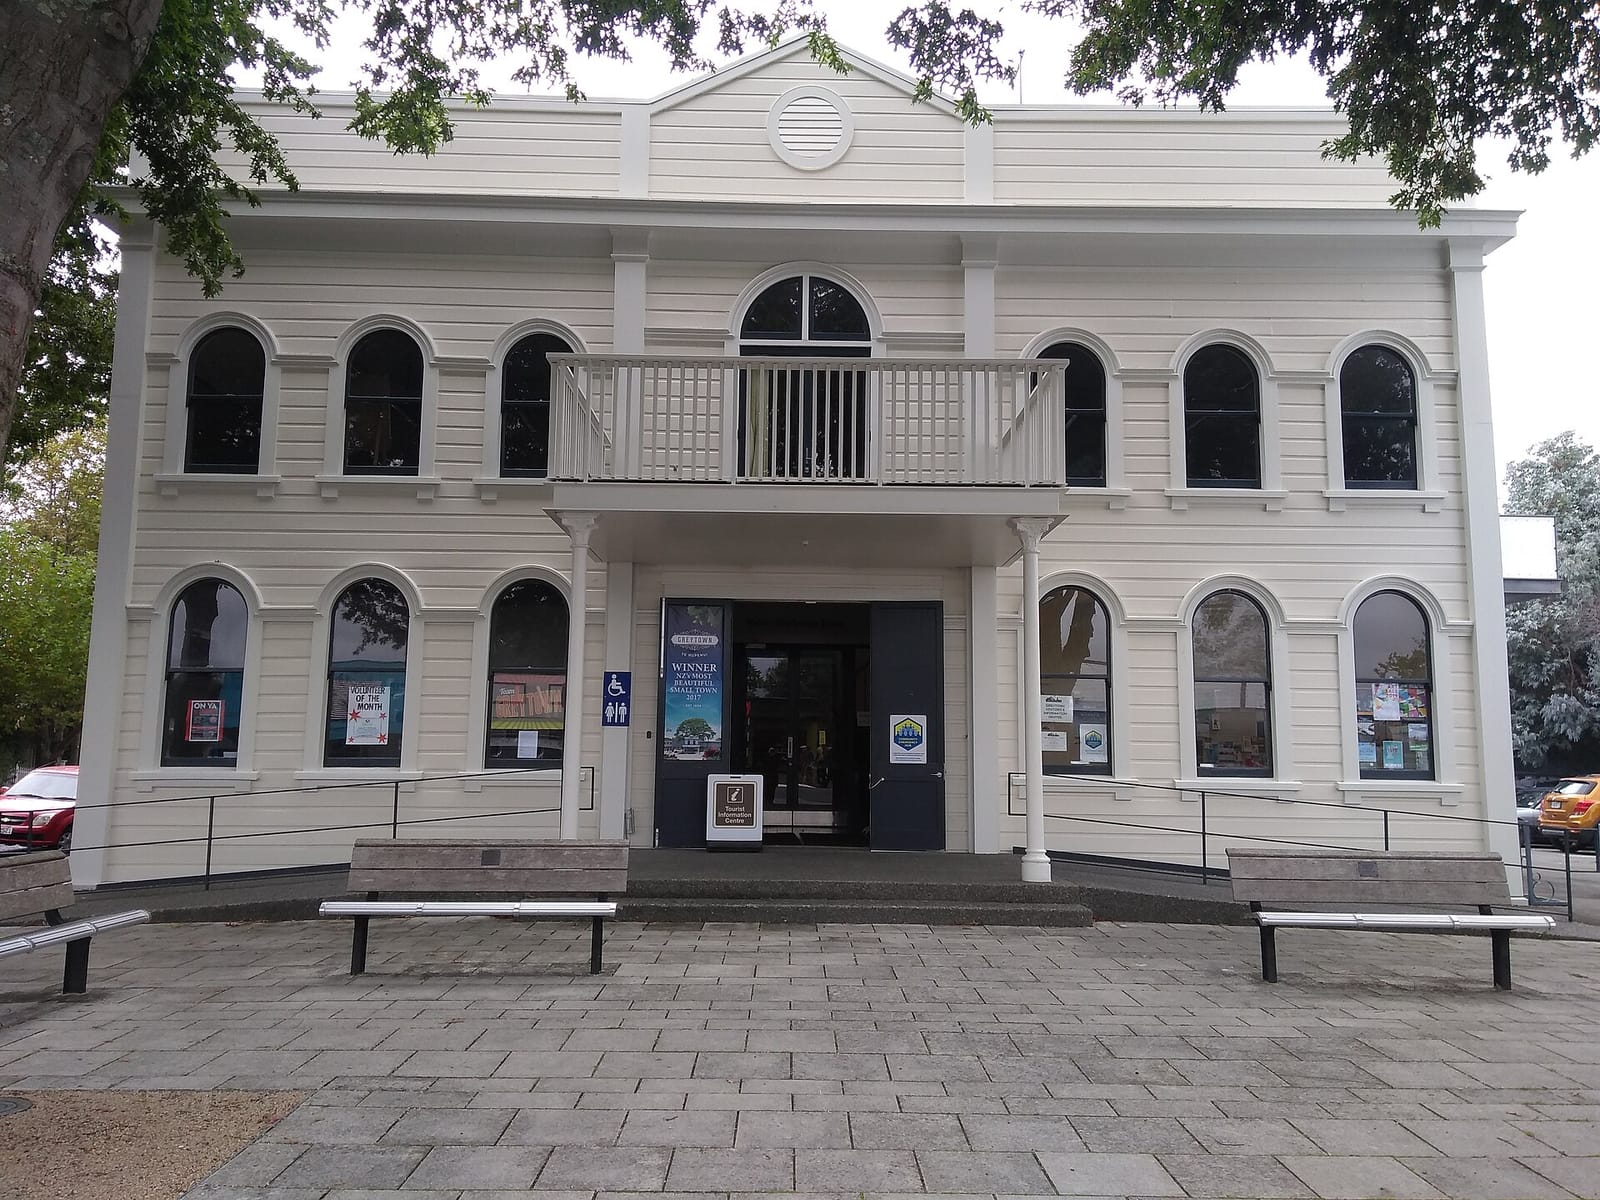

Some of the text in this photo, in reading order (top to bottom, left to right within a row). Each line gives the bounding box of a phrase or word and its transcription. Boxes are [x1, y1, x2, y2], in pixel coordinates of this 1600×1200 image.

[671, 662, 717, 672] WINNER
[350, 686, 386, 695] VOLUNTEER
[670, 686, 693, 694] SMALL
[355, 694, 380, 703] OF THE
[357, 702, 383, 711] MONTH
